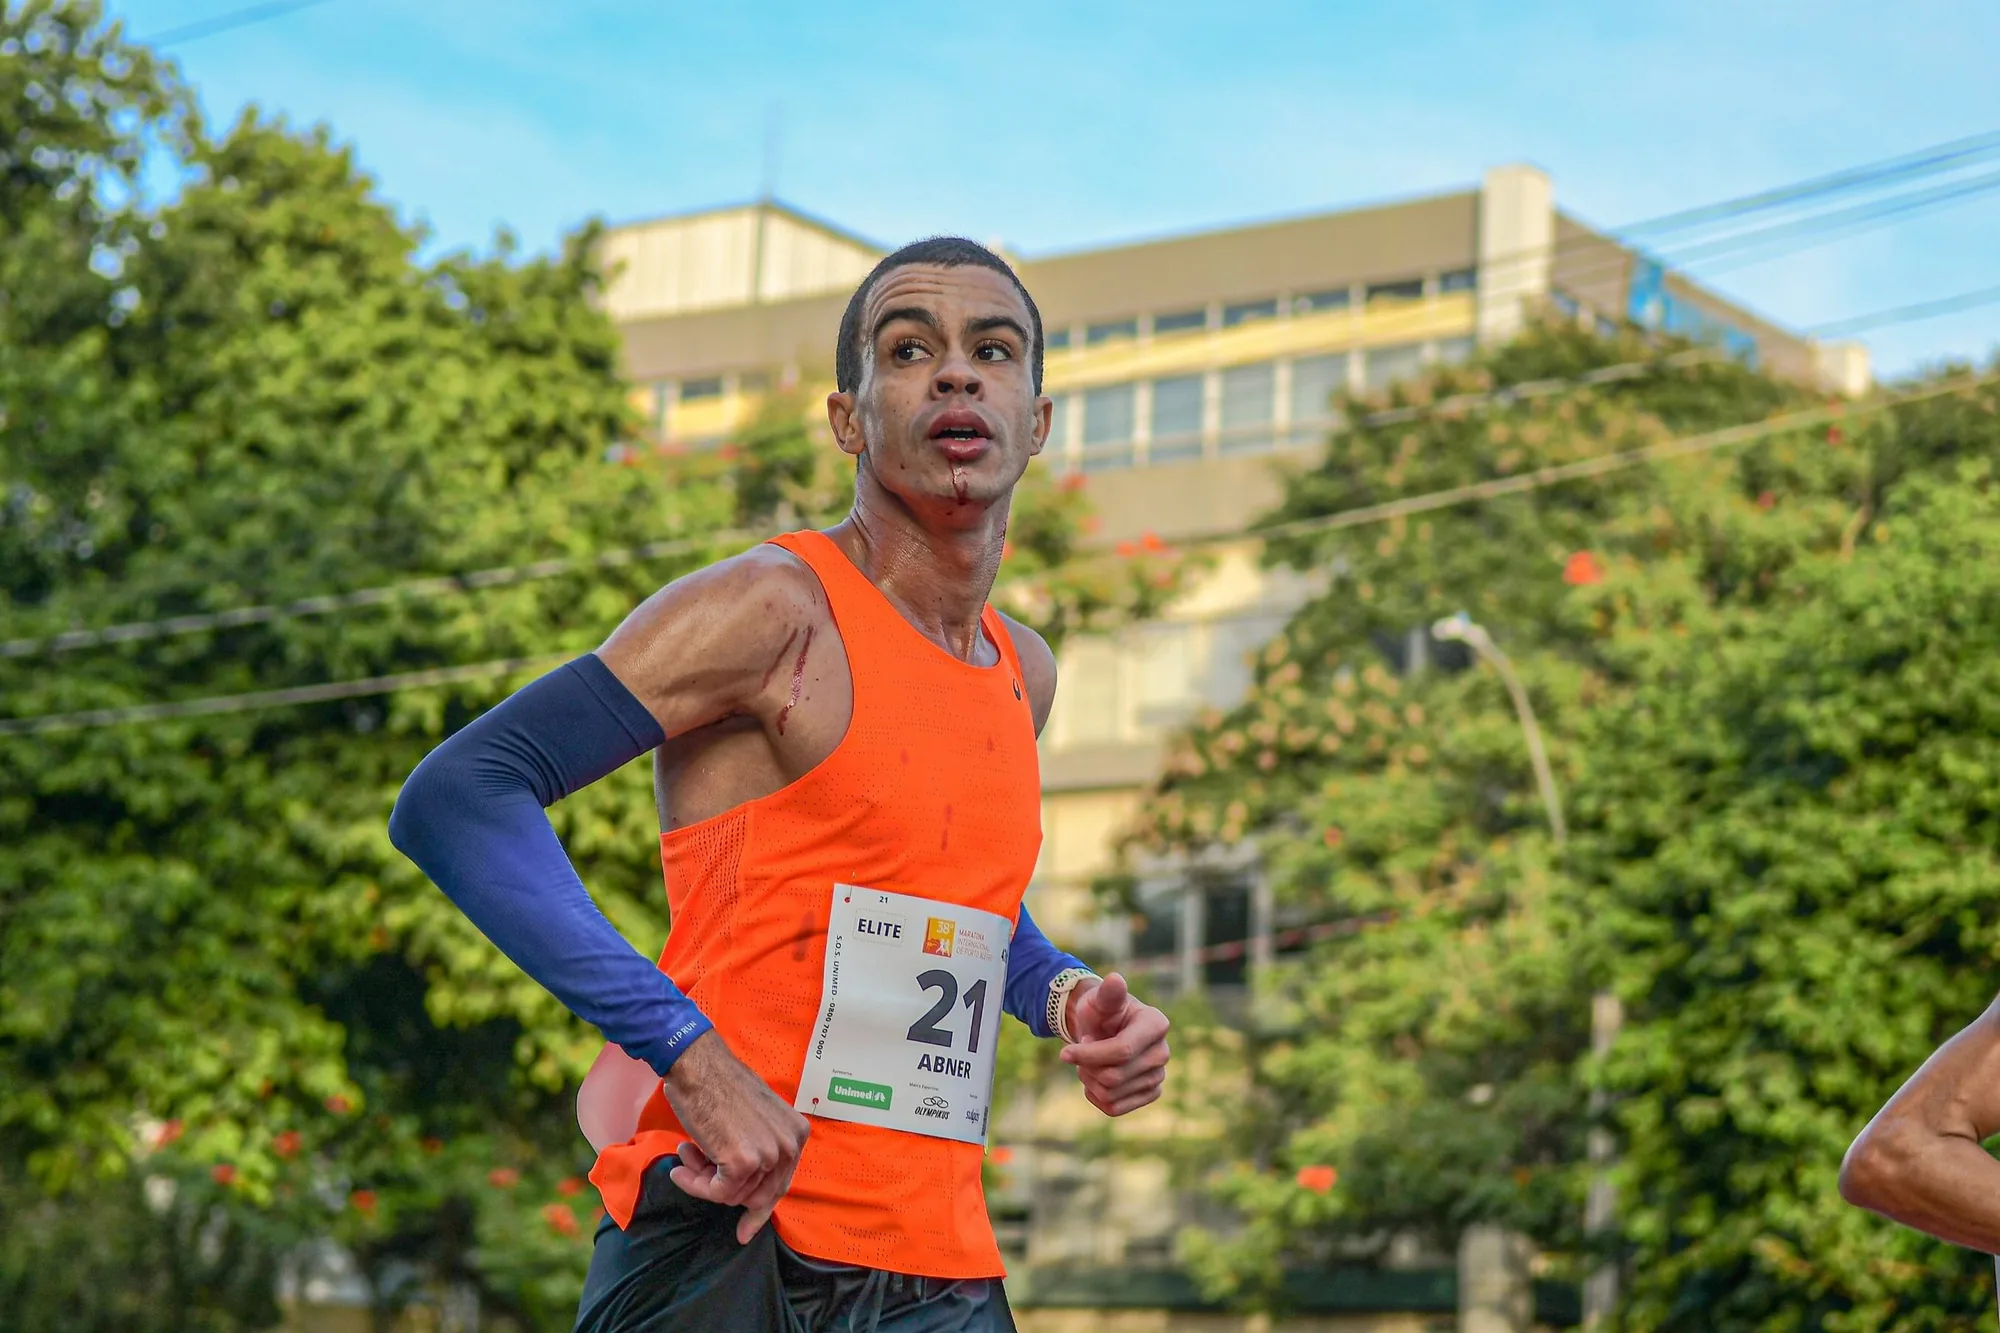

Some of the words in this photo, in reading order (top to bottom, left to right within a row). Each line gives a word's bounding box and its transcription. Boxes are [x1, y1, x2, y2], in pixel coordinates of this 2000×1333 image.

[879, 895, 888, 904] 21
[857, 918, 902, 939] ELITE
[831, 960, 840, 996] UNIMED
[825, 1002, 836, 1022] 0800
[906, 969, 987, 1053] 21
[667, 1020, 697, 1048] KIPRUN
[820, 1023, 830, 1039] 707
[813, 1039, 825, 1060] 0007
[918, 1053, 971, 1079] ABNER
[834, 1085, 873, 1101] Unimed
[914, 1106, 950, 1120] OLYMPIKUS
